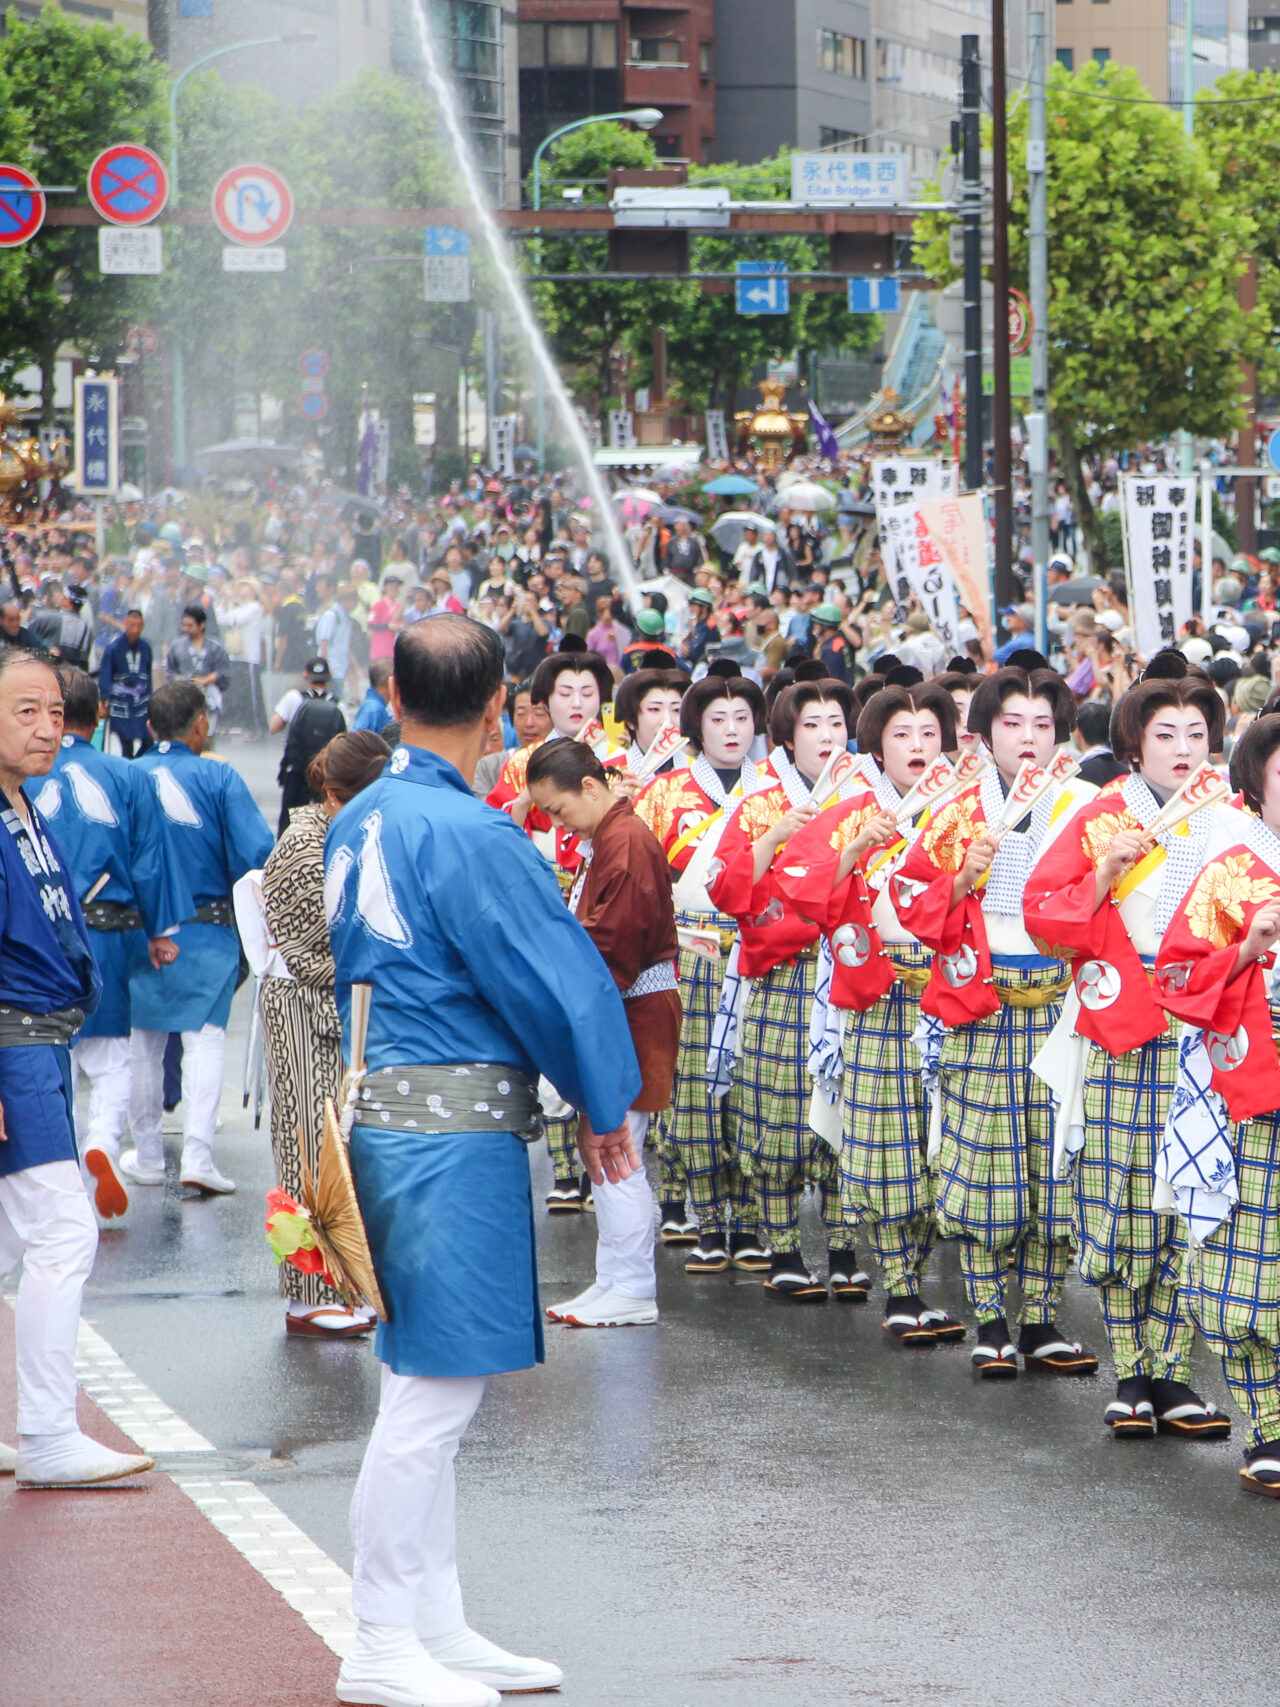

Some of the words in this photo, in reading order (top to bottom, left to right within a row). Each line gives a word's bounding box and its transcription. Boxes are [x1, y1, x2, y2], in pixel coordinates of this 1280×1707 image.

[802, 161, 896, 181] 永代橋西
[87, 391, 107, 481] 永代橋
